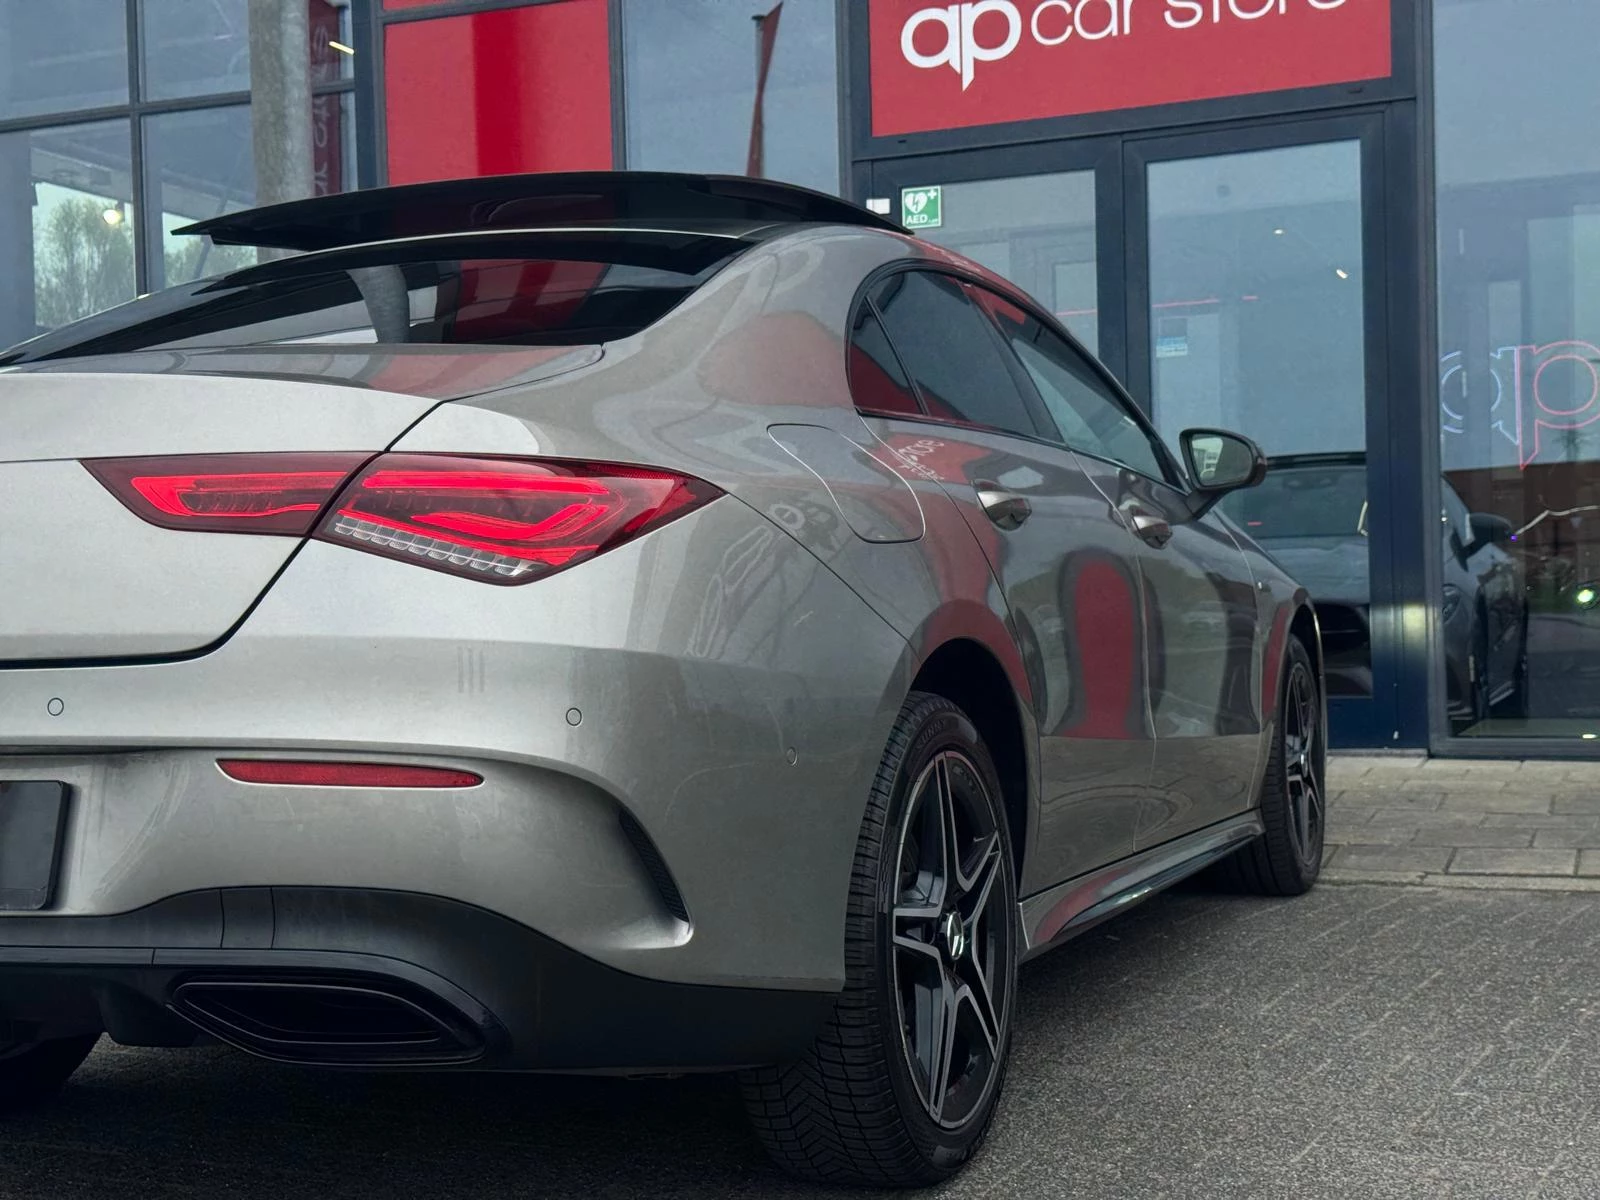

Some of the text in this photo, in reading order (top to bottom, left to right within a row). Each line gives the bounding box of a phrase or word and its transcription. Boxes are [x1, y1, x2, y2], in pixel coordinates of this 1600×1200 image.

[901, 0, 1022, 92] ap
[1030, 0, 1134, 45] car
[907, 214, 928, 224] AED
